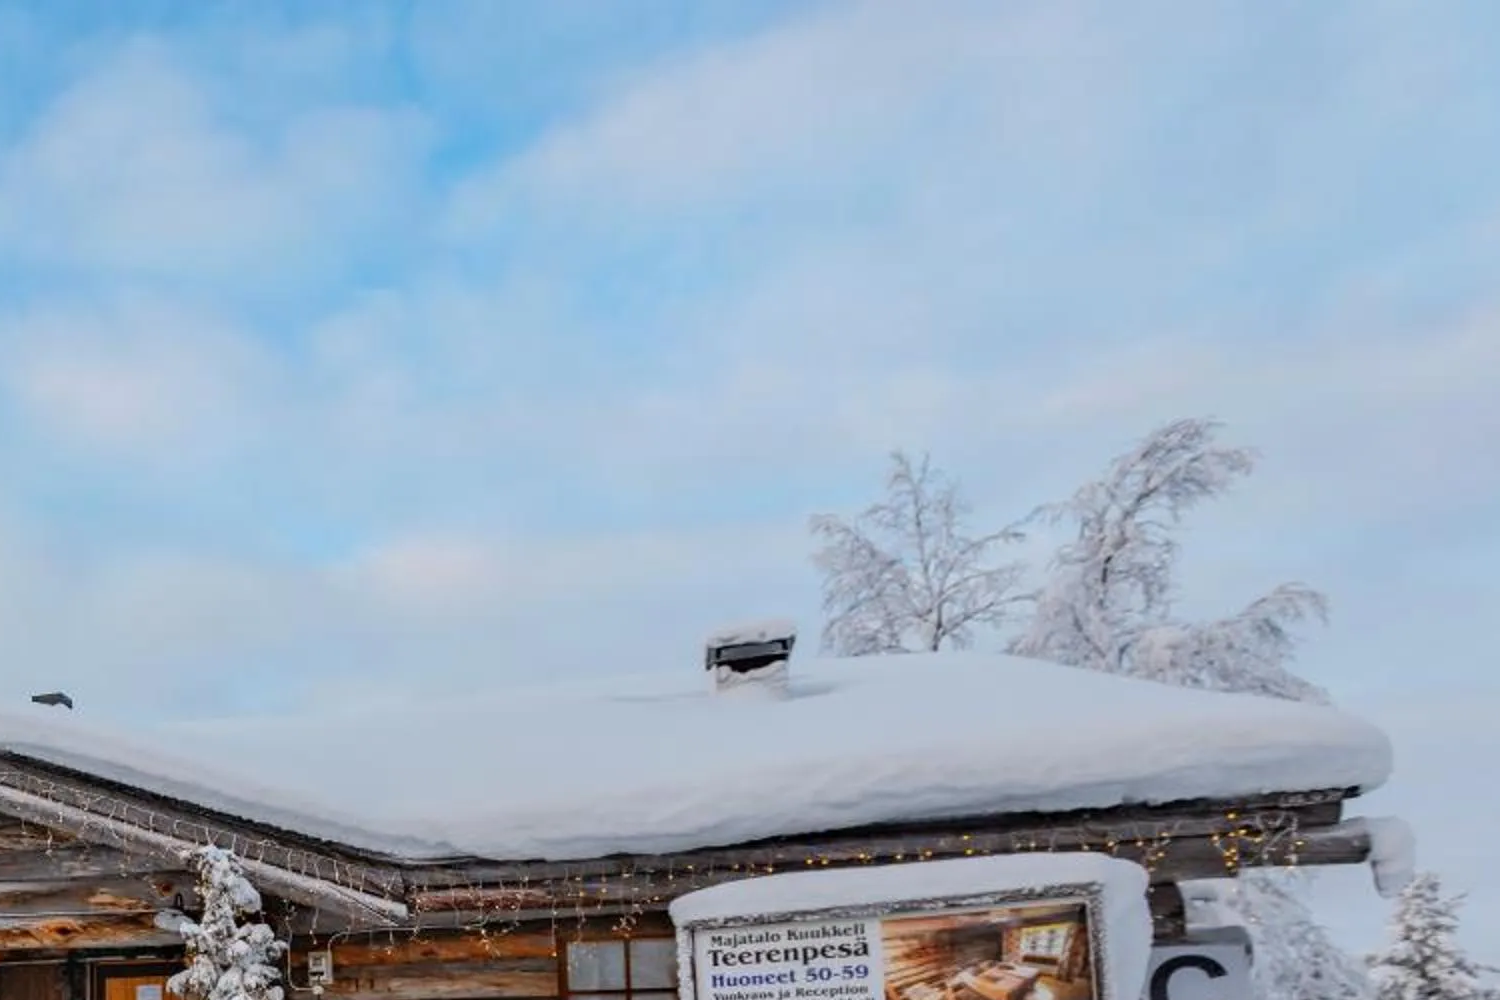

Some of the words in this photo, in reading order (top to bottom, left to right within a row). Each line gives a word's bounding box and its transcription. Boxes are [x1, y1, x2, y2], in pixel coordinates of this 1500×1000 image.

[710, 931, 781, 948] Majatalo
[787, 923, 866, 942] Kuukkeli
[708, 936, 870, 967] Teerenpesä
[711, 970, 797, 988] Huoneet
[805, 964, 870, 982] 50-59
[778, 989, 791, 1000] ja
[795, 984, 869, 999] Reception
